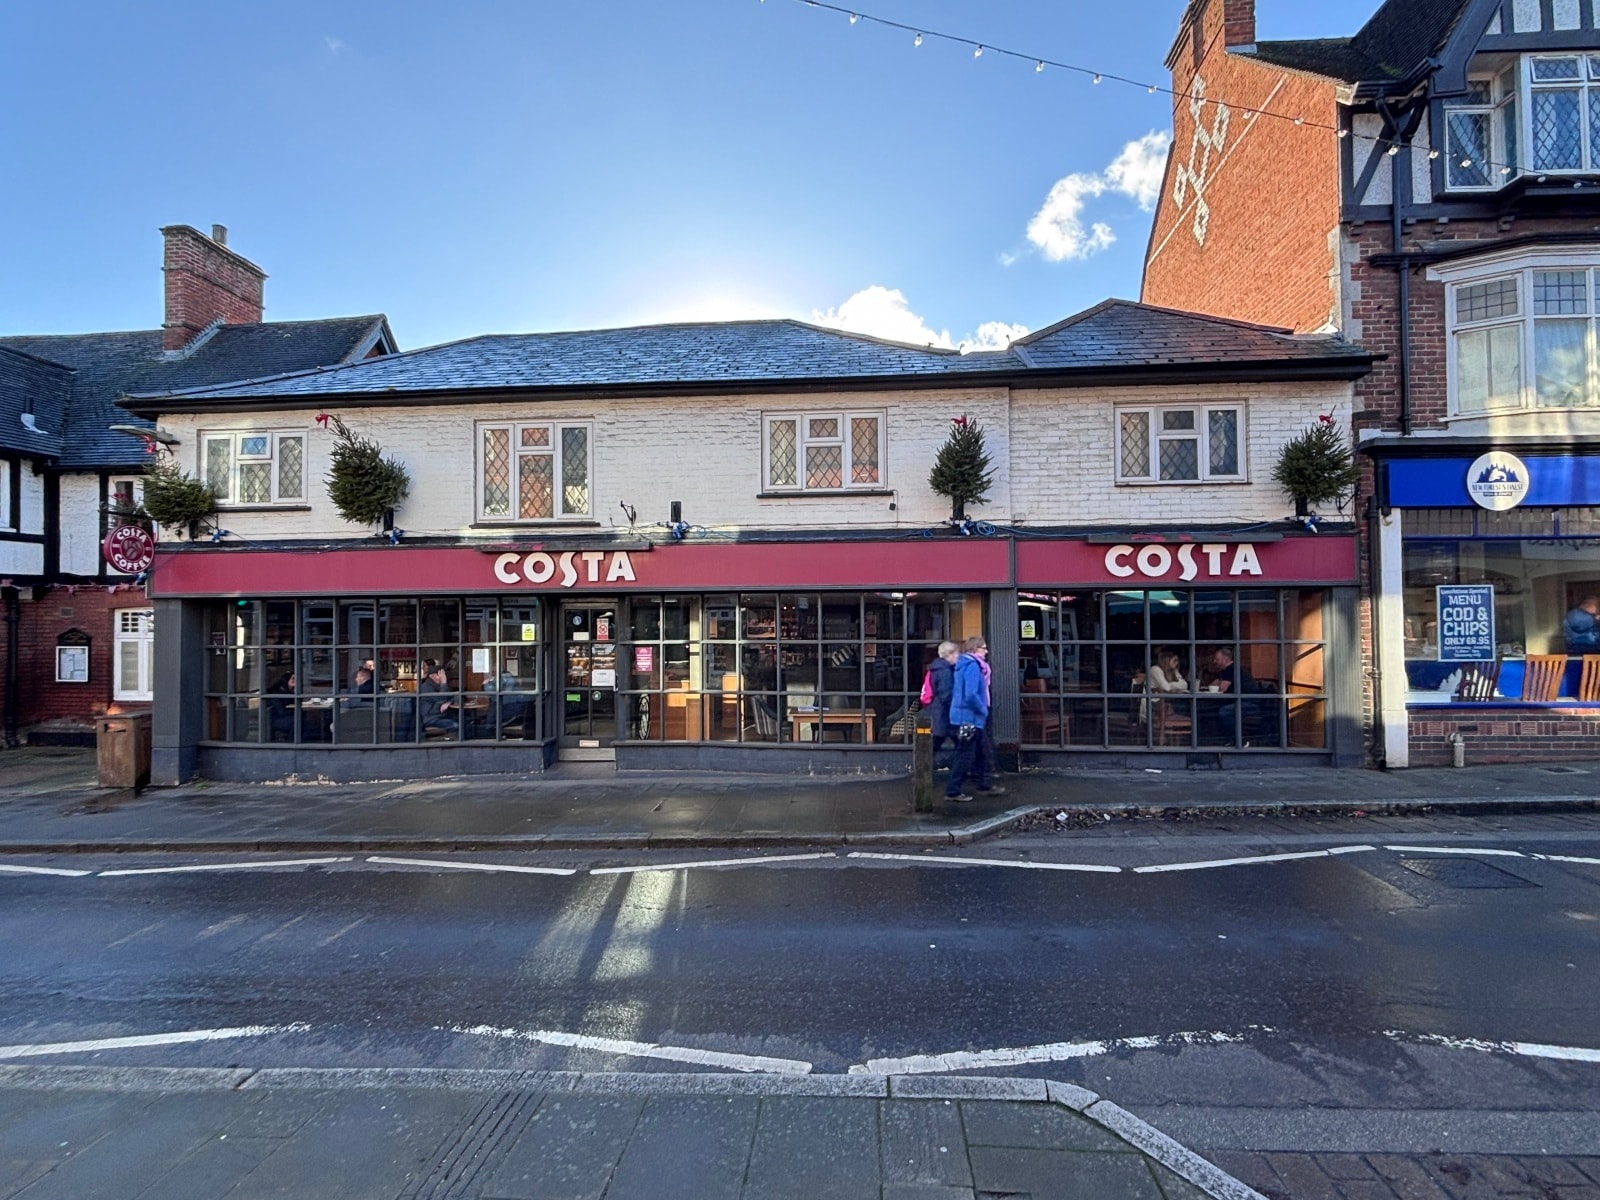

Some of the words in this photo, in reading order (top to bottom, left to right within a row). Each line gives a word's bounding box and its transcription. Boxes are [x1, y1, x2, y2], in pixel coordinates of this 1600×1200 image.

[117, 528, 147, 543] COSTA
[115, 553, 150, 570] COFFEE
[1104, 543, 1263, 582] COSTA
[494, 551, 636, 588] COSTA
[1448, 594, 1482, 605] MENU
[1443, 607, 1474, 621] COD
[1477, 607, 1489, 621] &
[1443, 621, 1489, 636] CHIPS
[1444, 637, 1465, 646] ONLY
